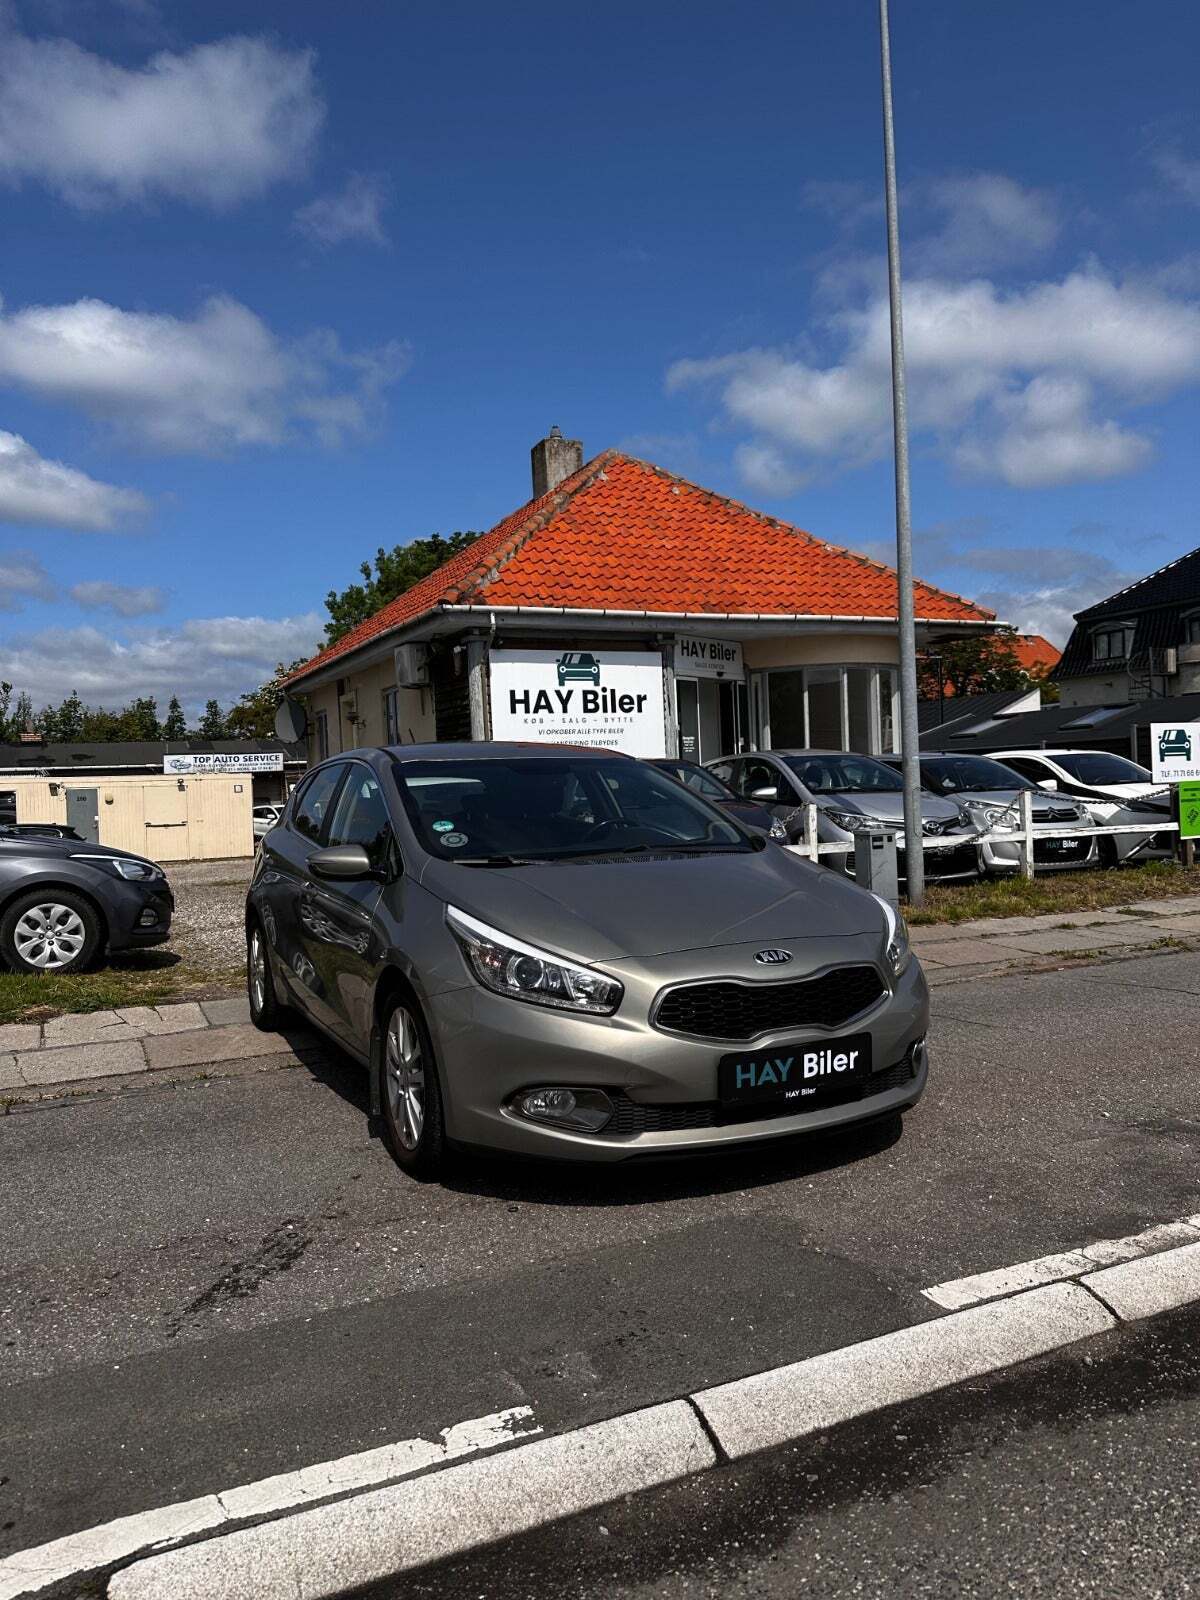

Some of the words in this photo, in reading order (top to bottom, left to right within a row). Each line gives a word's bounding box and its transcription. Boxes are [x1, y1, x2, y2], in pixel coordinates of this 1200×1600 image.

[681, 639, 706, 658] HAY
[710, 643, 736, 661] Biler
[509, 689, 574, 714] HAY
[582, 687, 647, 714] Biler
[193, 756, 211, 764] TOP
[213, 755, 240, 763] AUTO
[243, 754, 280, 762] SERVICE
[1047, 840, 1061, 849] HAY
[1062, 840, 1079, 848] Biler
[759, 951, 789, 962] KIA
[735, 1057, 795, 1089] HAY
[803, 1050, 859, 1078] Biler
[785, 1089, 800, 1098] HAY
[801, 1087, 816, 1096] Biler
